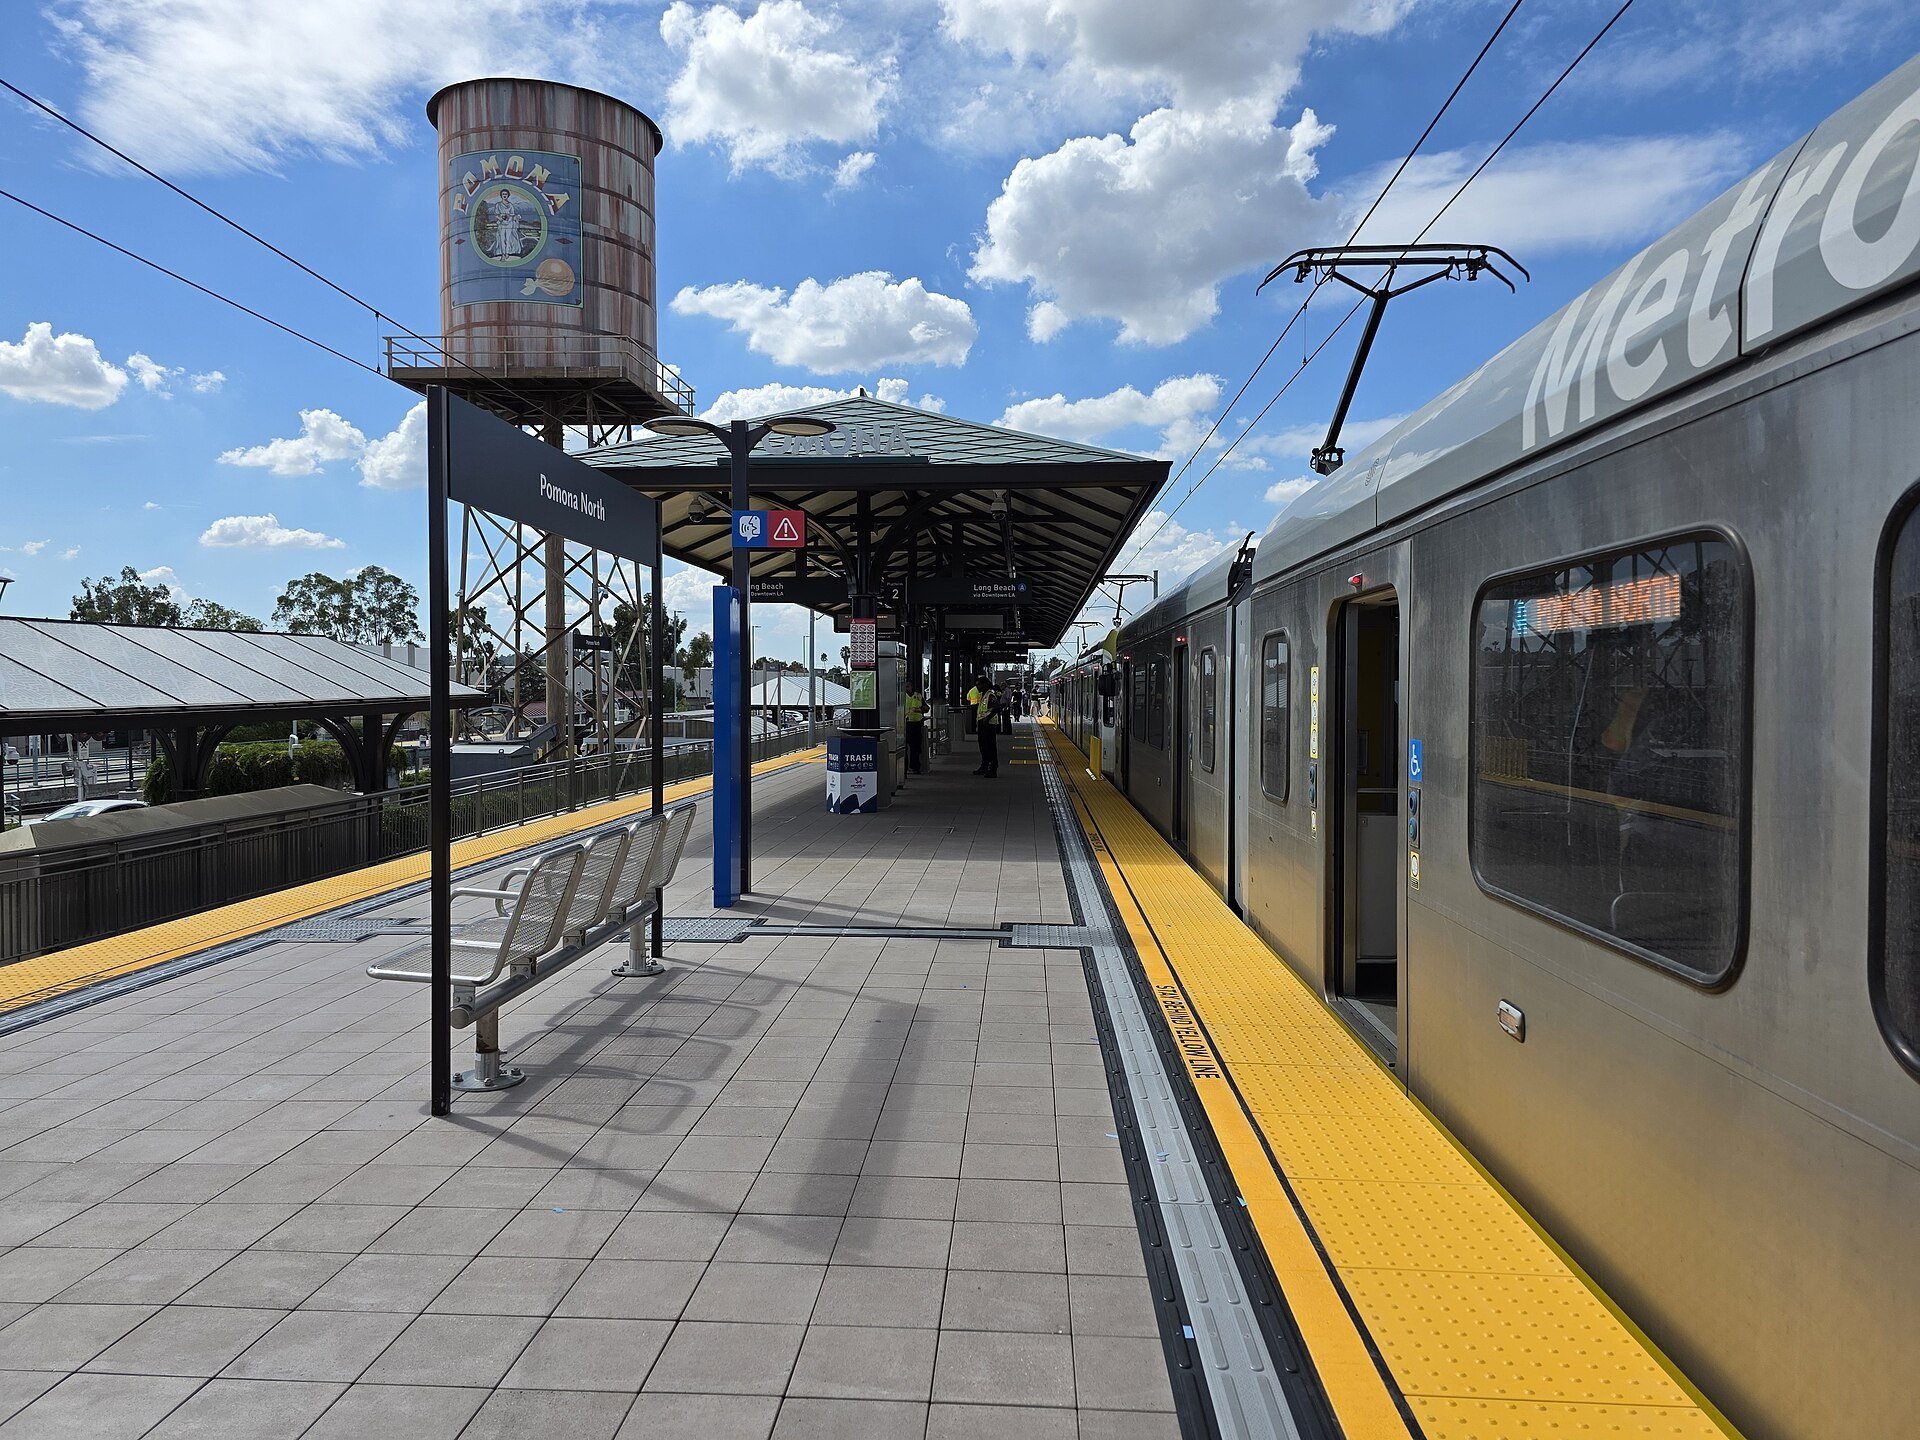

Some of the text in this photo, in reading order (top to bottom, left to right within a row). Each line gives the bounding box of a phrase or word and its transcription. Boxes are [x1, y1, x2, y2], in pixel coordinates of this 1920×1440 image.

[453, 154, 571, 216] POMONA
[1521, 86, 1920, 452] Metro
[754, 423, 913, 456] OMONA
[540, 473, 606, 522] Pomona North
[761, 582, 784, 590] Beach
[892, 588, 899, 600] 2
[973, 584, 992, 593] Long
[1536, 588, 1603, 631] POMONA
[1610, 573, 1680, 623] NORTH
[844, 754, 873, 762] TRASH
[1155, 985, 1221, 1079] STAY BEHIND YELLOW LINE
